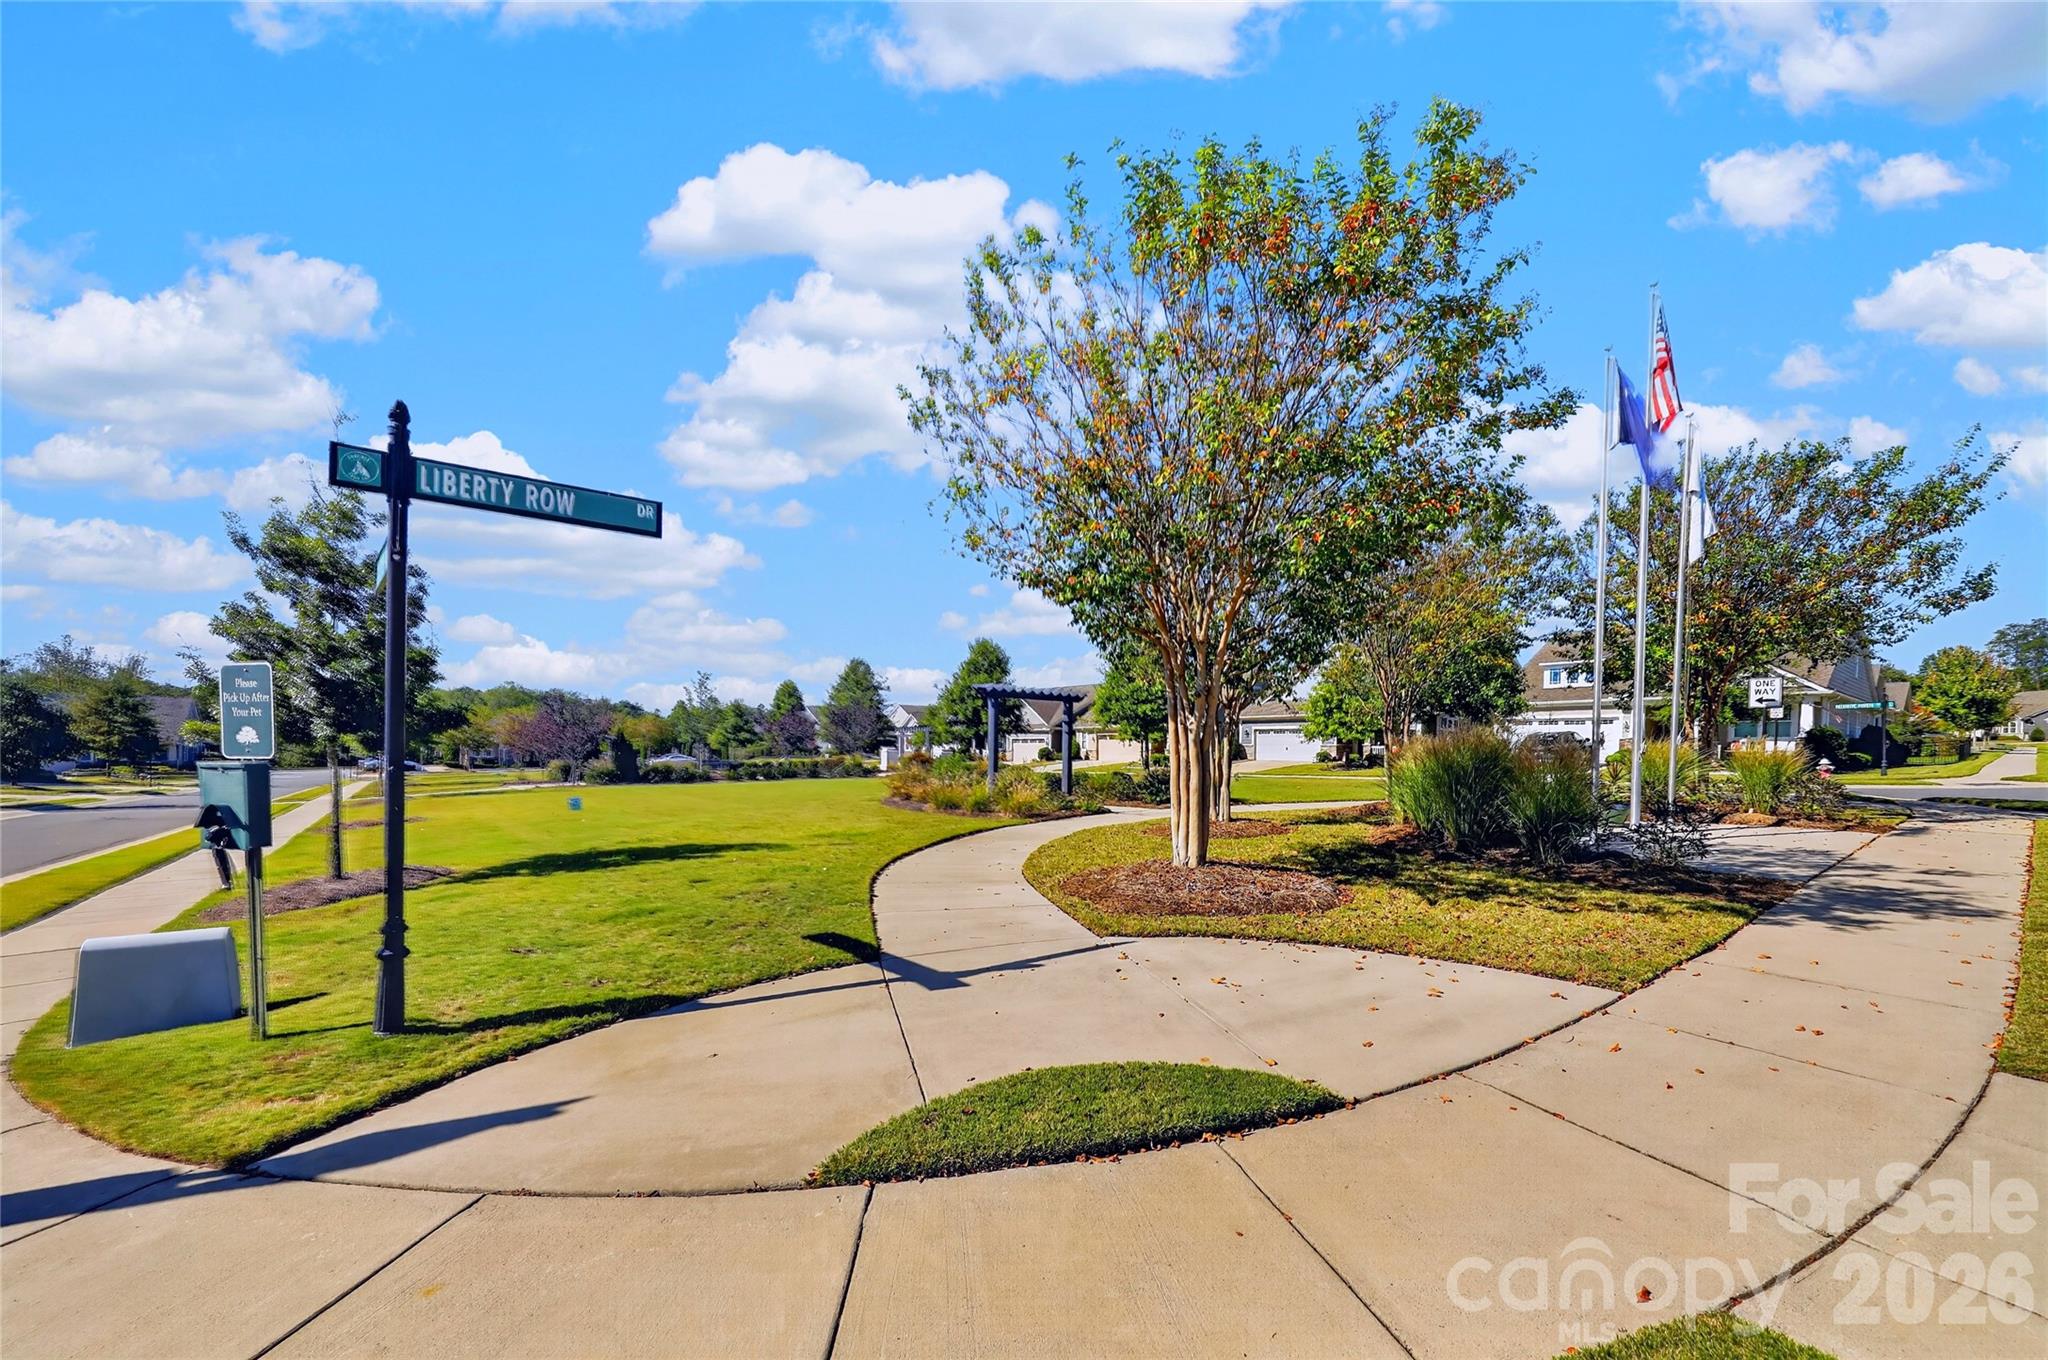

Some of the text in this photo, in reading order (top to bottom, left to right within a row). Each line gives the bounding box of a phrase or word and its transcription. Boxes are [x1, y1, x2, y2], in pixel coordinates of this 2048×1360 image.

[420, 464, 655, 519] LIBERTY ROW DR
[235, 678, 258, 688] Please
[223, 691, 270, 705] Pick Up After
[231, 707, 262, 717] Your Pet
